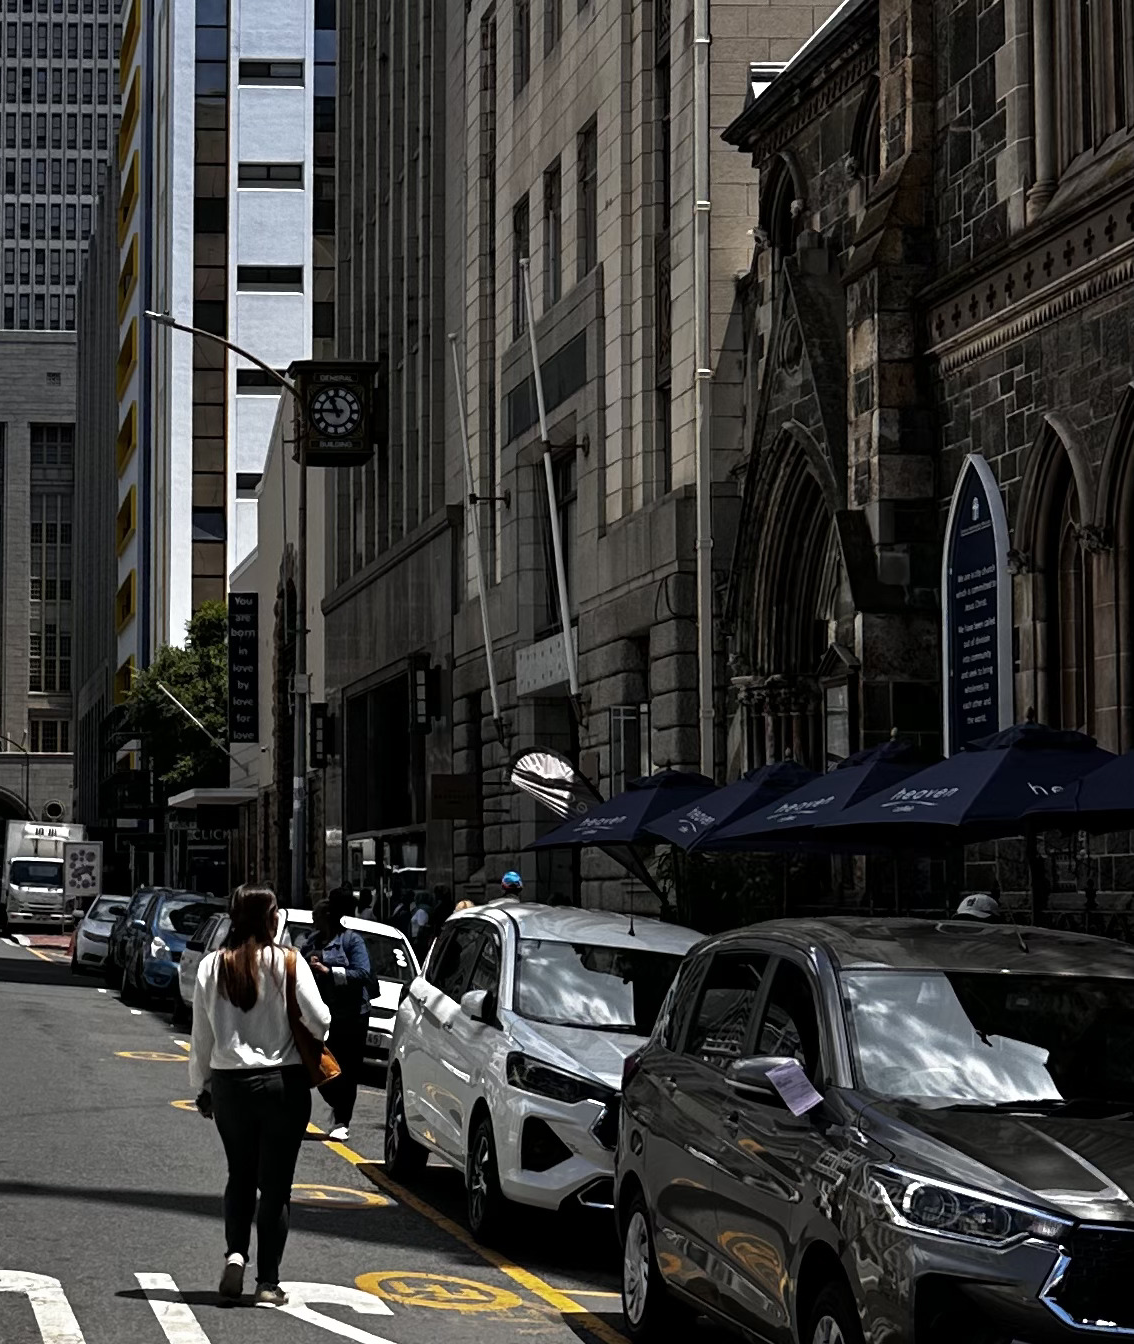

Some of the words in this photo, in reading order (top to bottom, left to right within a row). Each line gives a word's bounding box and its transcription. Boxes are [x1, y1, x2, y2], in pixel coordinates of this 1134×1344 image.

[319, 440, 353, 448] BUILDING
[235, 597, 253, 606] You
[235, 614, 251, 622] are
[231, 628, 255, 636] born
[239, 646, 248, 655] in
[233, 663, 254, 672] love
[238, 680, 250, 690] by
[233, 697, 254, 706] love
[236, 714, 250, 722] for
[233, 731, 254, 739] love
[890, 787, 959, 801] heaven
[774, 795, 835, 813] heaven
[578, 815, 628, 827] heaven
